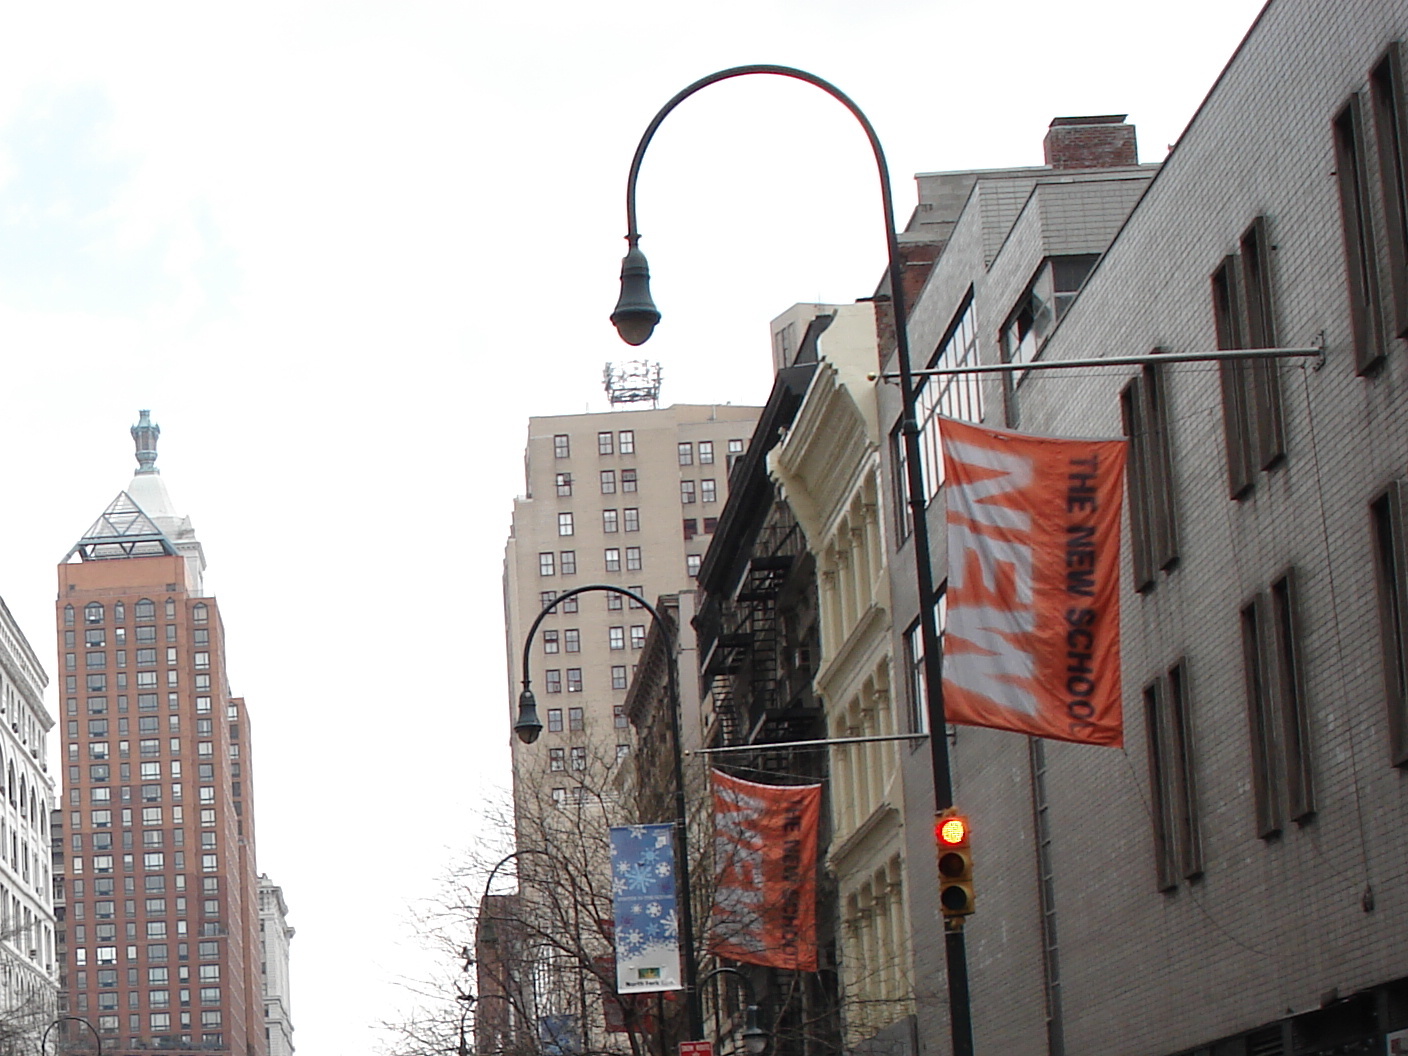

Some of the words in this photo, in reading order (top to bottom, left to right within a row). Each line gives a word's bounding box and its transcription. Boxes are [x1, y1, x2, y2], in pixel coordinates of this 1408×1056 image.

[1067, 455, 1098, 514] THE
[942, 439, 1037, 717] NEW
[1065, 525, 1096, 597] NEW
[1065, 607, 1096, 733] SCHOOL
